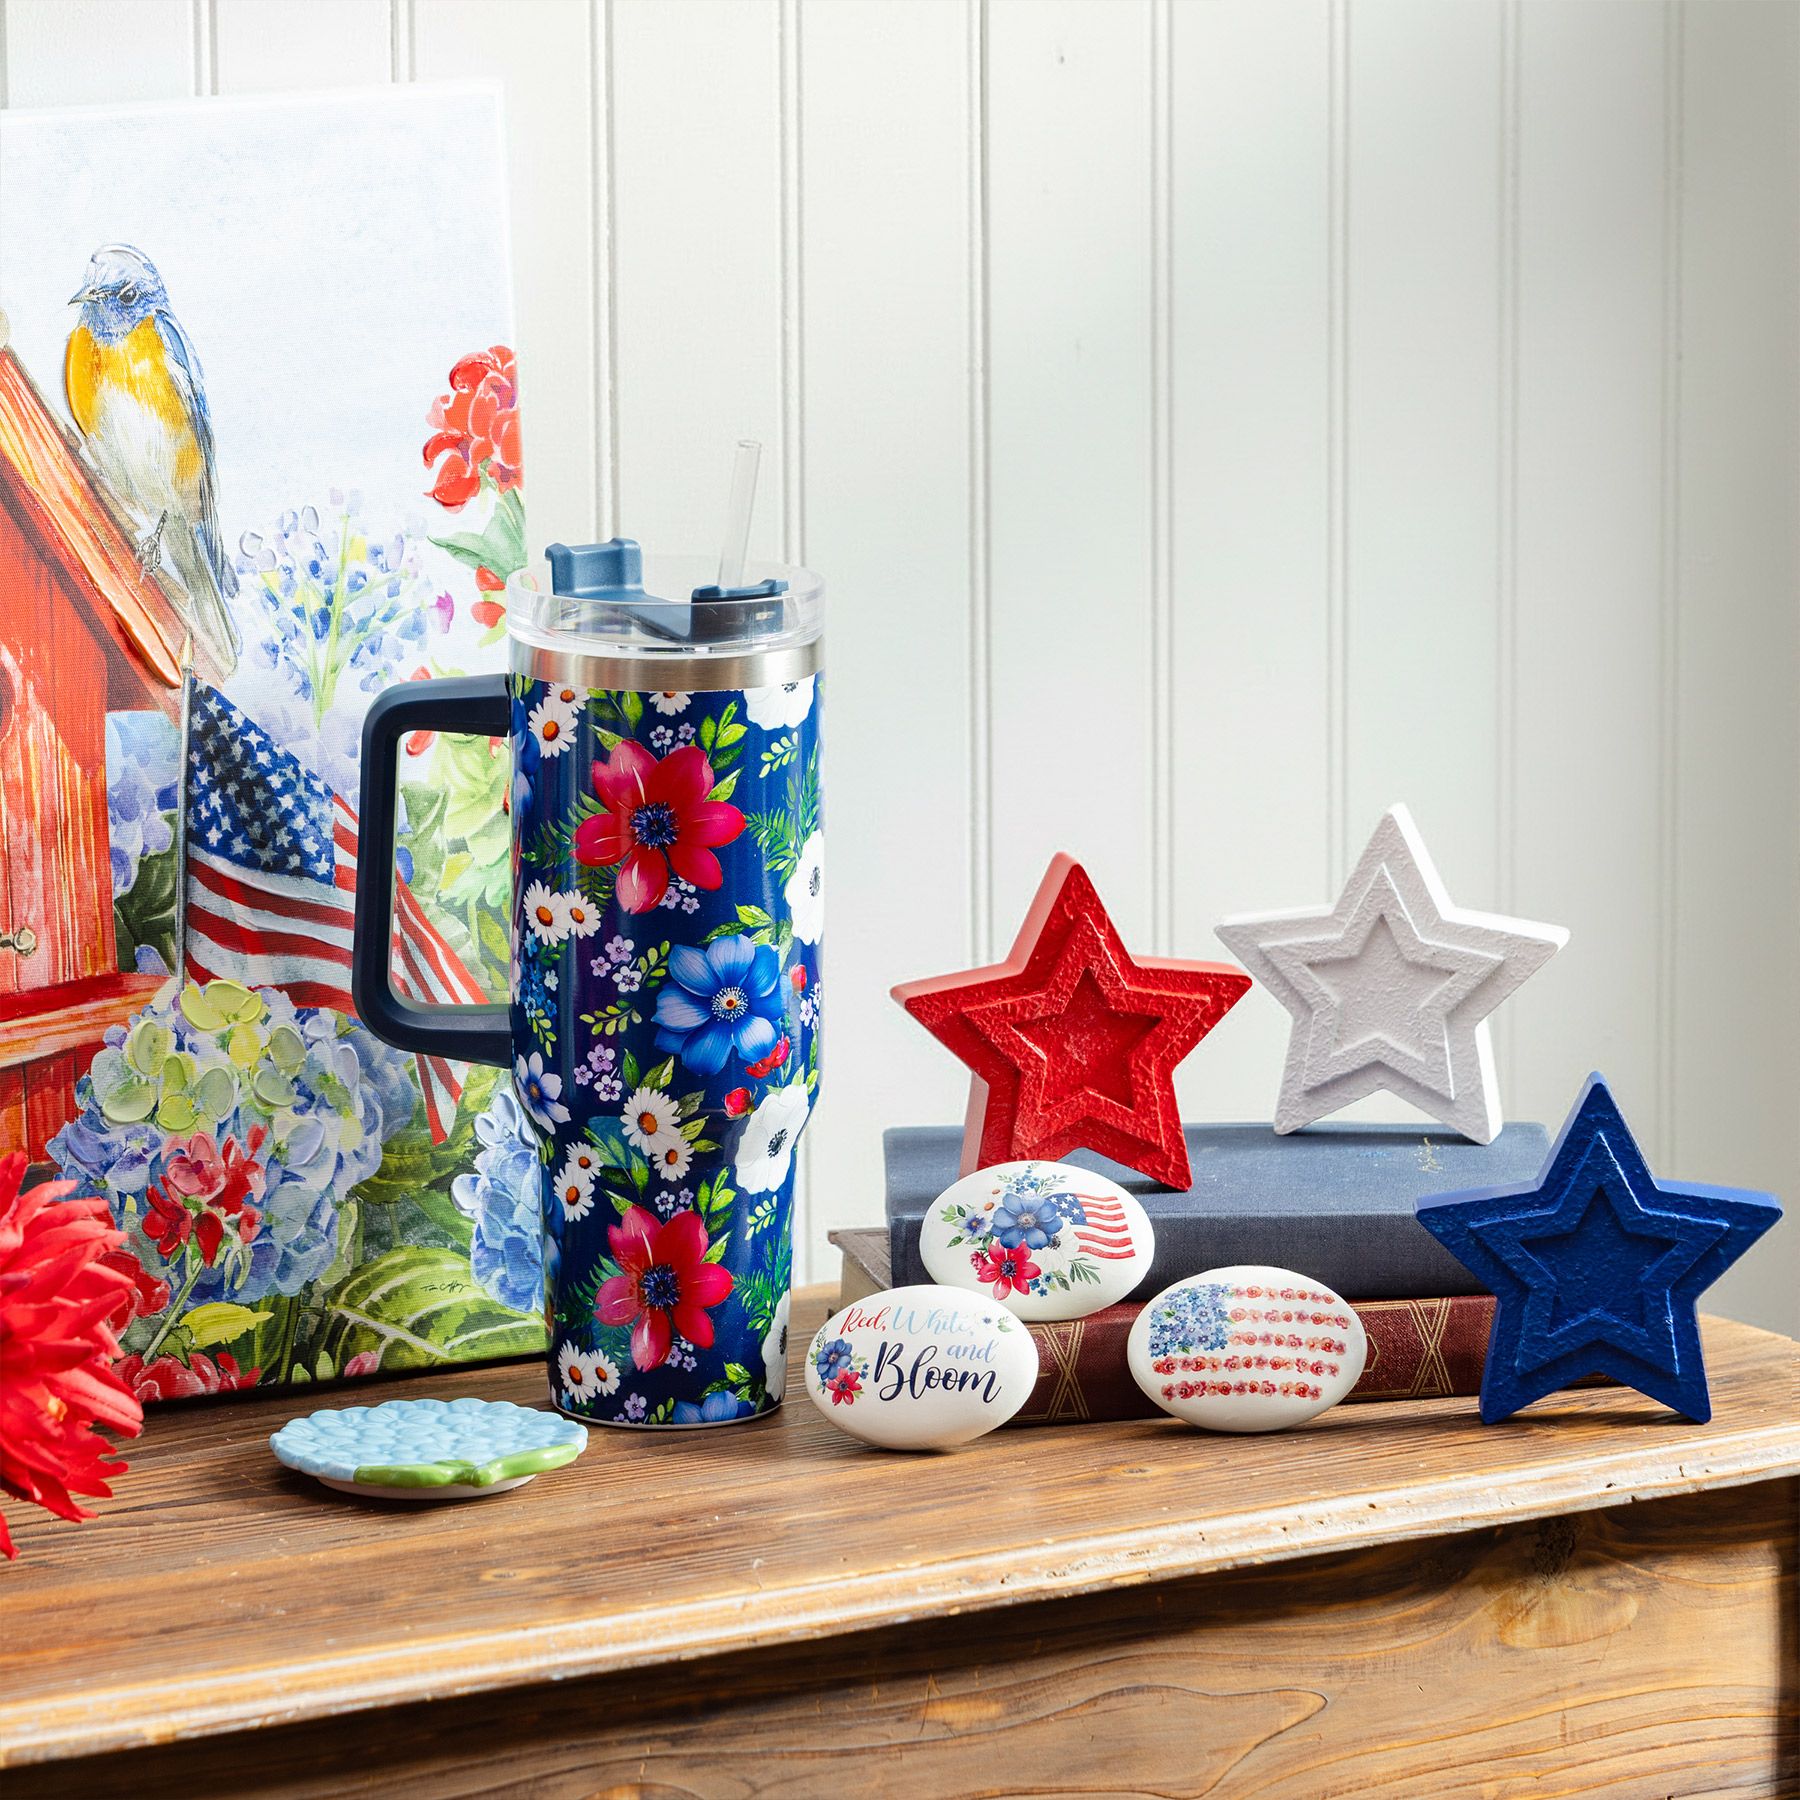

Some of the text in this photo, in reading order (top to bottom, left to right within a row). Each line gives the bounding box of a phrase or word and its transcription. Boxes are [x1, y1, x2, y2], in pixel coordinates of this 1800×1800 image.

[840, 1306, 974, 1336] Red, White,
[947, 1339, 999, 1363] and
[874, 1341, 1002, 1404] Bloom
